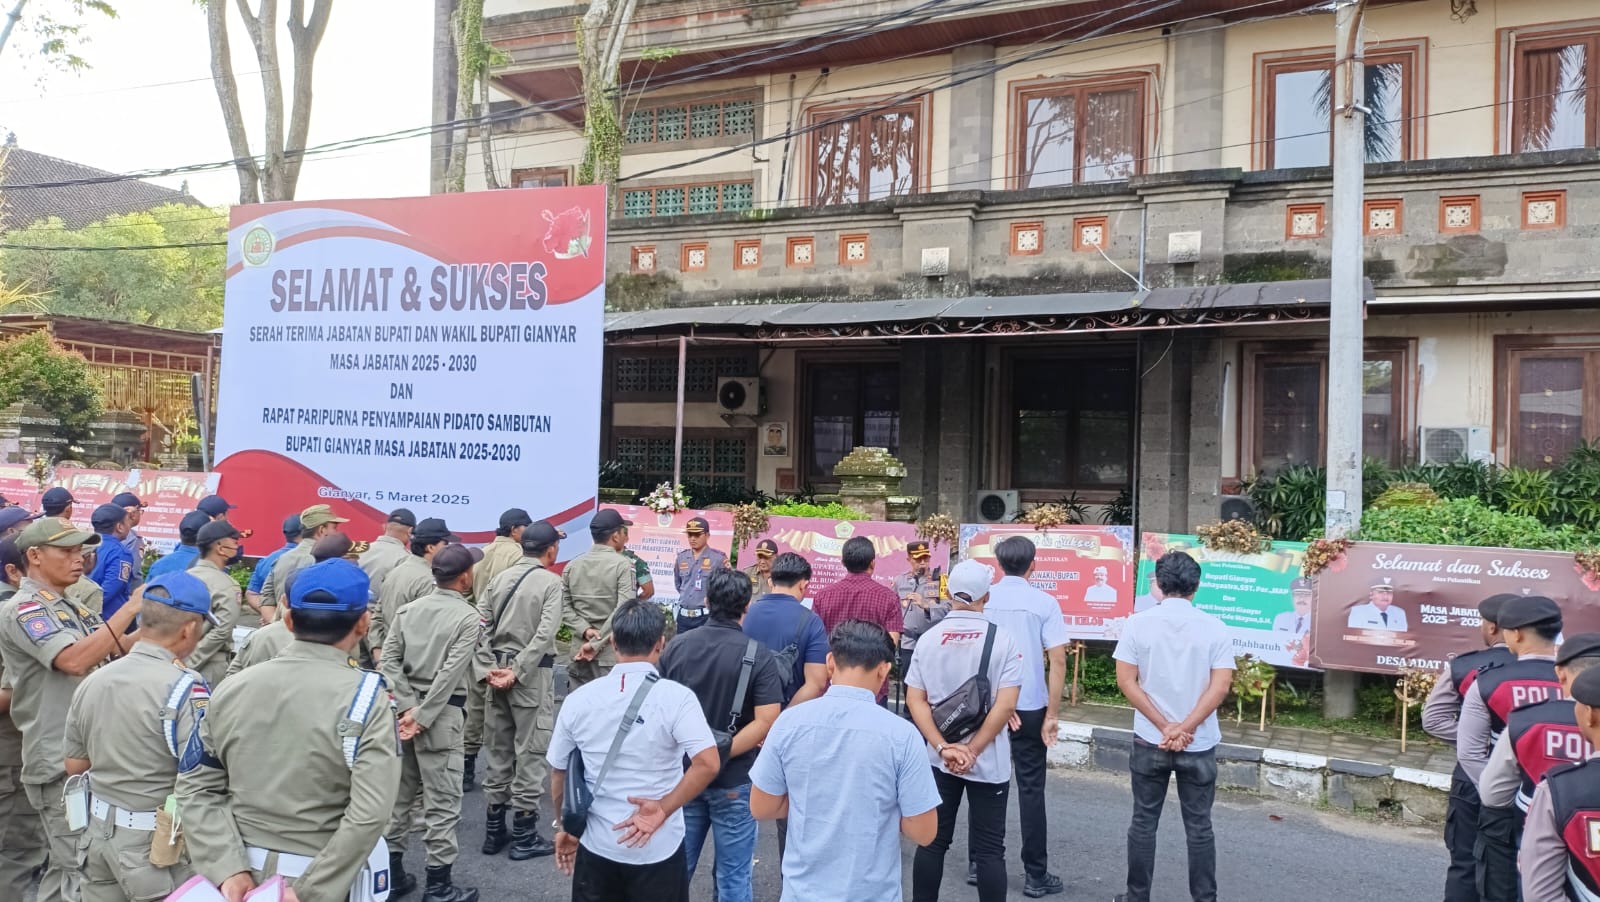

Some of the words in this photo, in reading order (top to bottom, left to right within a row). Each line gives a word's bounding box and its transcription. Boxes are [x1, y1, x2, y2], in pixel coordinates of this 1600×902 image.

[269, 267, 394, 313] SELAMAT
[400, 265, 421, 312] &
[428, 262, 547, 312] SUKSES
[249, 325, 284, 343] SERAH
[286, 325, 324, 342] TERIMA
[326, 325, 372, 342] JABATAN
[374, 325, 412, 342] BUPATI
[415, 325, 439, 342] DAN
[441, 325, 478, 343] WAKIL
[480, 325, 521, 343] BUPATI
[523, 325, 577, 343] GIANYAR
[330, 353, 360, 370] MASA
[362, 354, 409, 371] JABATAN
[411, 354, 440, 371] 2025
[448, 354, 477, 372] 2030
[390, 382, 414, 400] DAN
[262, 407, 296, 424] RAPAT
[297, 409, 359, 427] PARIPURNA
[361, 410, 441, 429] PENYAMPAIAN
[443, 412, 485, 431] PIDATO
[487, 413, 552, 433] SAMBUTAN
[285, 435, 322, 453] BUPATI
[324, 437, 371, 456] GIANYAR
[374, 439, 406, 457] MASA
[407, 440, 457, 459] JABATAN
[459, 442, 521, 461] 2025-2030
[318, 487, 371, 501] Gianyar,
[375, 490, 384, 500] 5
[388, 491, 429, 503] Maret
[431, 493, 471, 505] 2025
[1056, 535, 1096, 549] Sukses
[1371, 553, 1443, 573] Selamat
[1446, 558, 1482, 576] dan
[1487, 559, 1551, 580] Sukses
[1057, 572, 1080, 580] BUPATI
[1229, 574, 1257, 583] Gianyar
[1030, 582, 1057, 590] GIANYAR
[1421, 614, 1448, 625] 2025
[1376, 655, 1407, 667] DESA
[1408, 658, 1441, 670] ADAT
